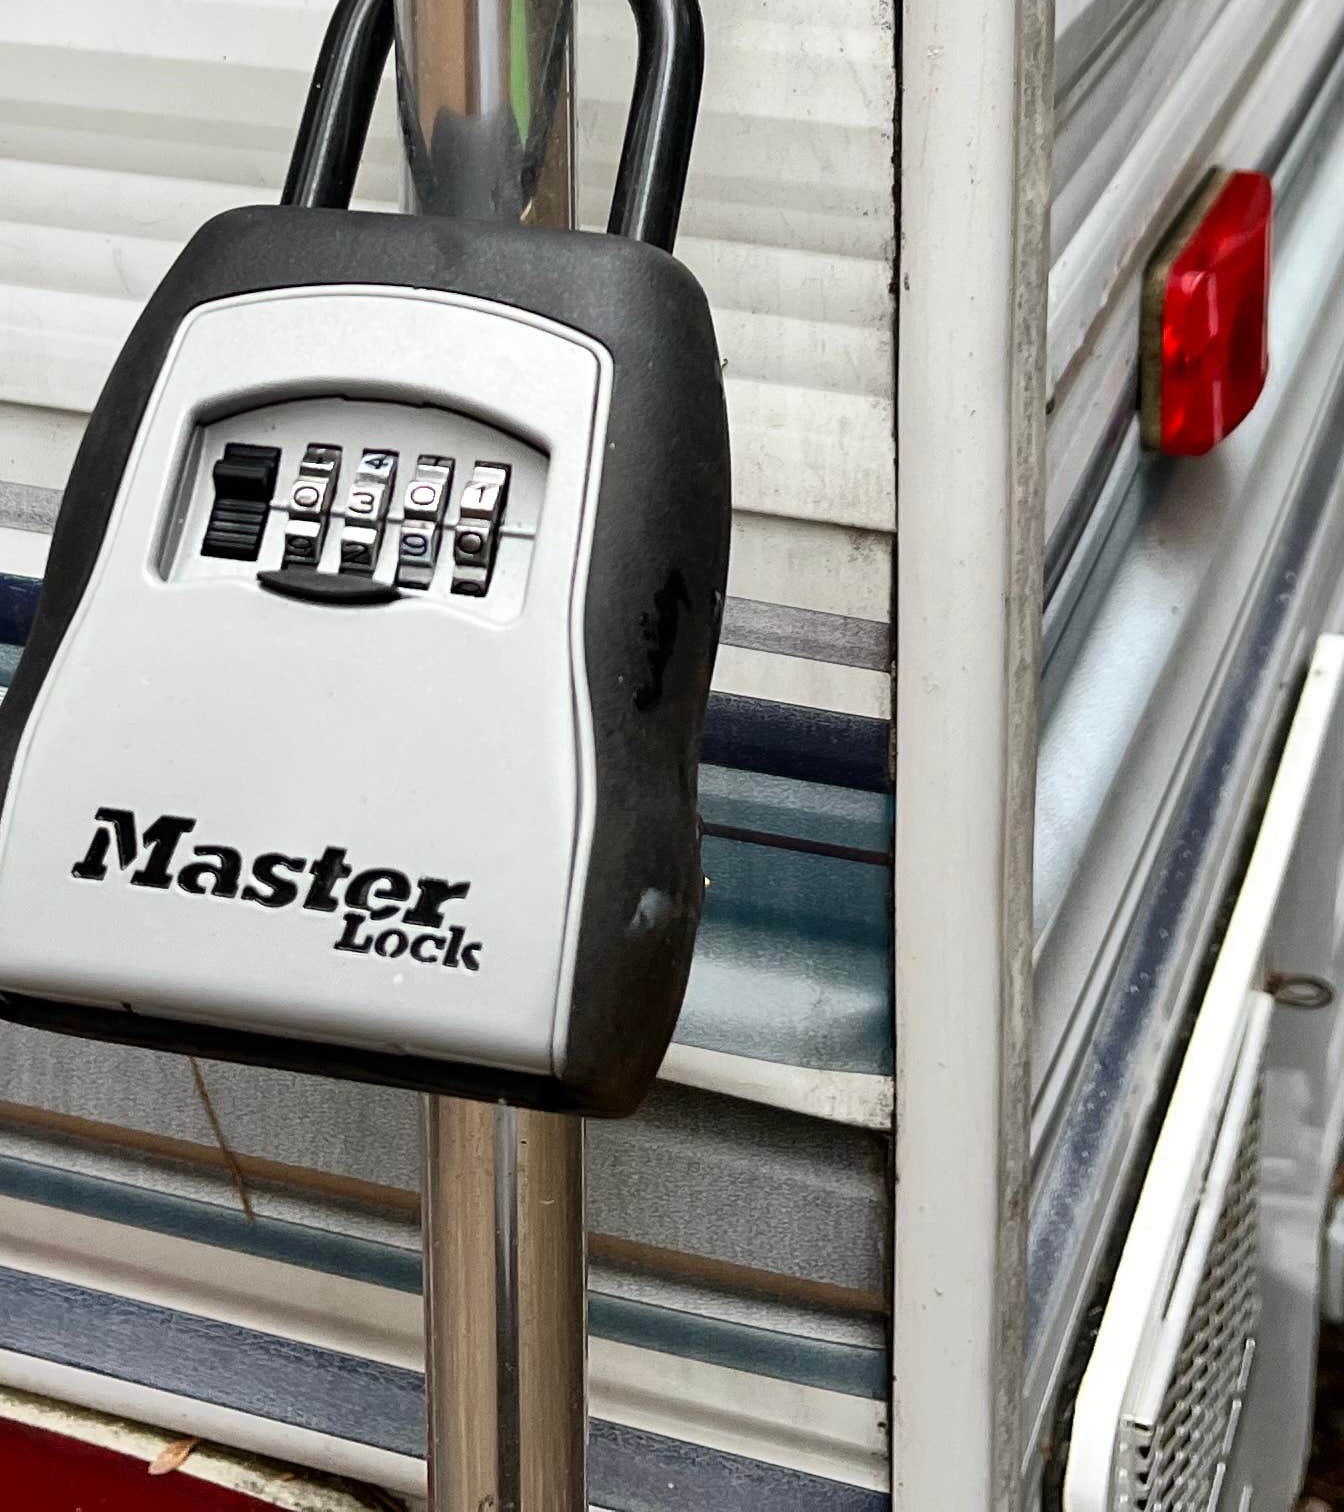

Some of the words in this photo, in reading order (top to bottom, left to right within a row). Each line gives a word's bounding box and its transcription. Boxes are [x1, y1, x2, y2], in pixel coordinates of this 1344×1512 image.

[293, 485, 320, 508] 0
[348, 491, 375, 514] 3
[410, 485, 436, 506] 0
[402, 533, 428, 557] 9
[457, 530, 484, 555] 0
[71, 806, 472, 929] Master
[333, 911, 484, 972] Lock
